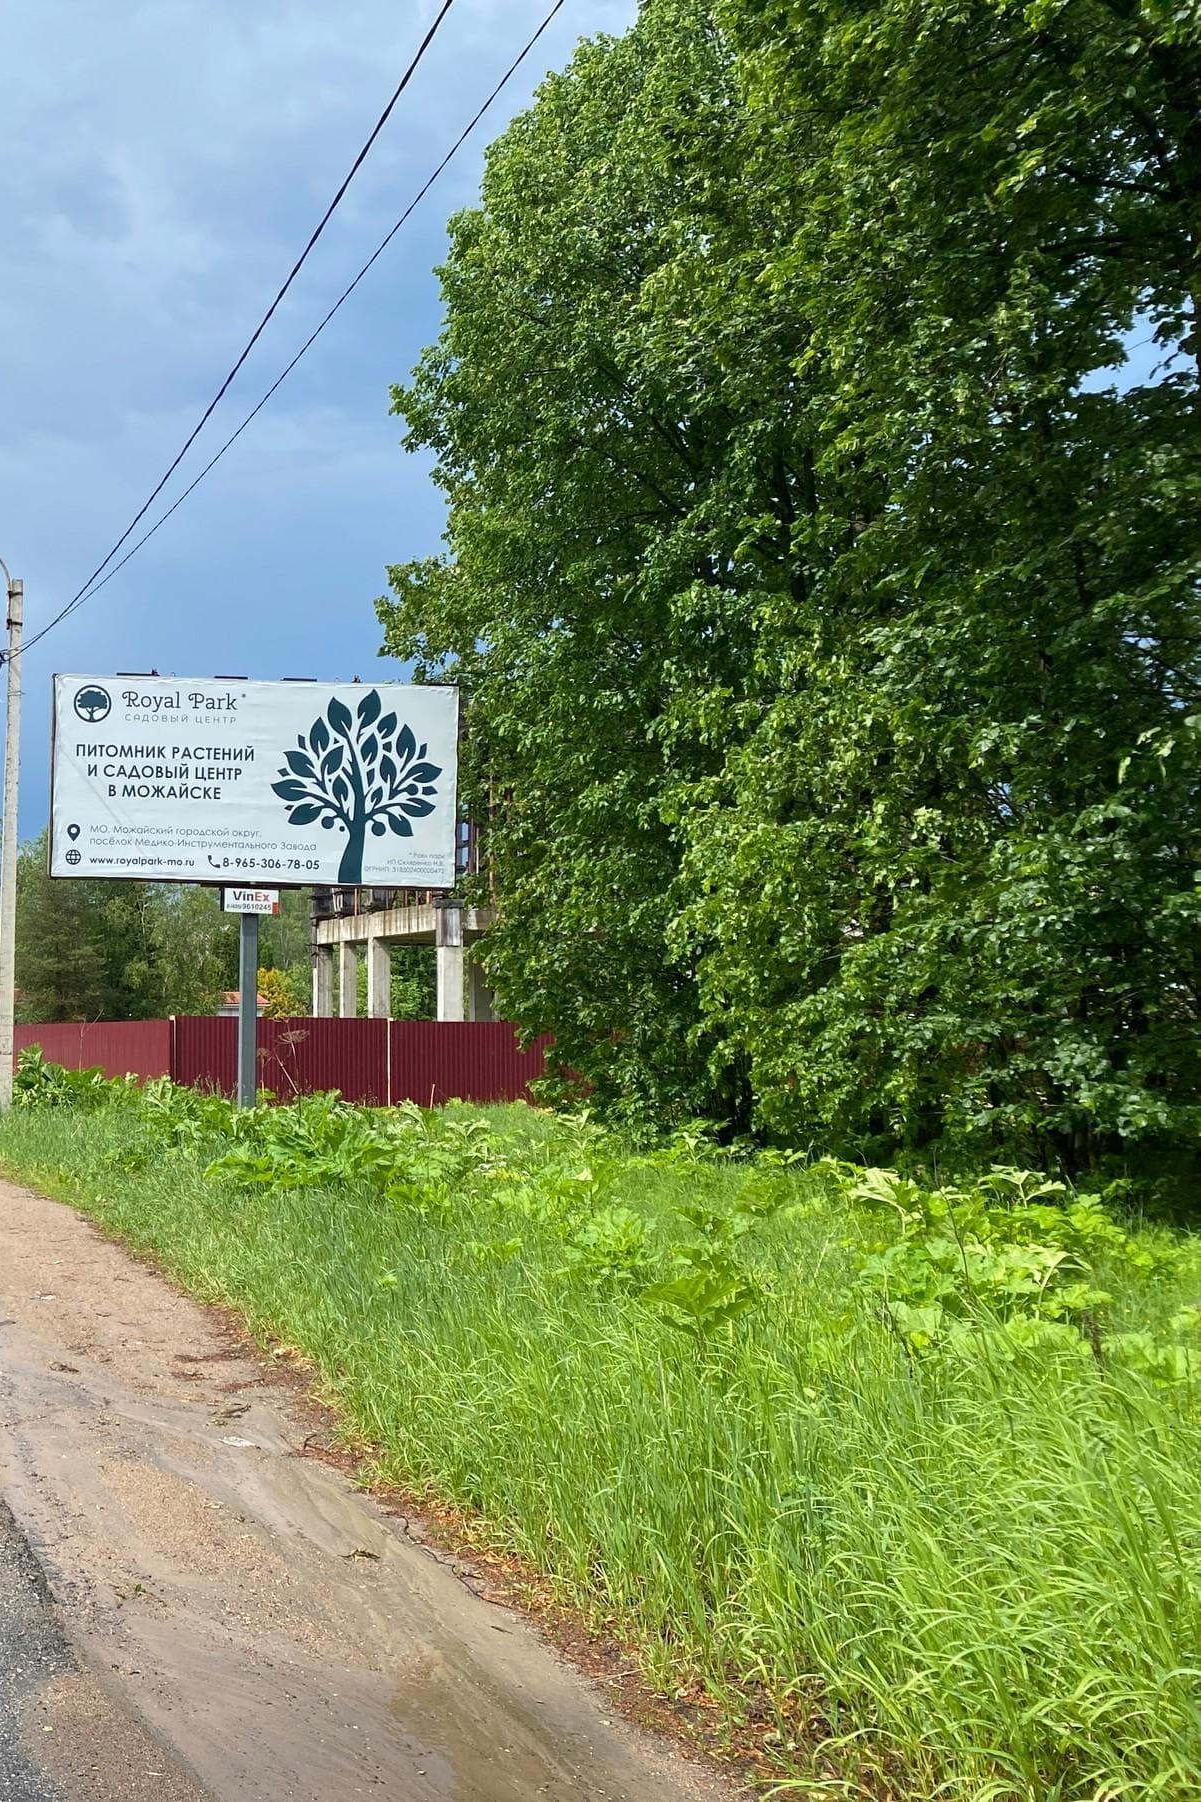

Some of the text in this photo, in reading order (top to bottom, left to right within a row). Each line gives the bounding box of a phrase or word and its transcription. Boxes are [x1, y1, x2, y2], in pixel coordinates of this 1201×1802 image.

[122, 691, 181, 712] Royal
[124, 713, 237, 724] САДОВЫЙ ЦЕНТР
[76, 744, 255, 761] ПИТОМНИК РАСТЕНИЙ
[87, 764, 242, 781] И САДОВЫЙ ЦЕНТР
[108, 783, 221, 800] В МОЖАЙСКЕ
[113, 825, 173, 836] Можайский
[176, 828, 230, 837] городской
[90, 837, 317, 851] посёлок Медико-Инструментального Завода
[89, 856, 320, 869] www.royalpark-mo.ru 8-965-306-78-05
[233, 890, 270, 902] VinEx
